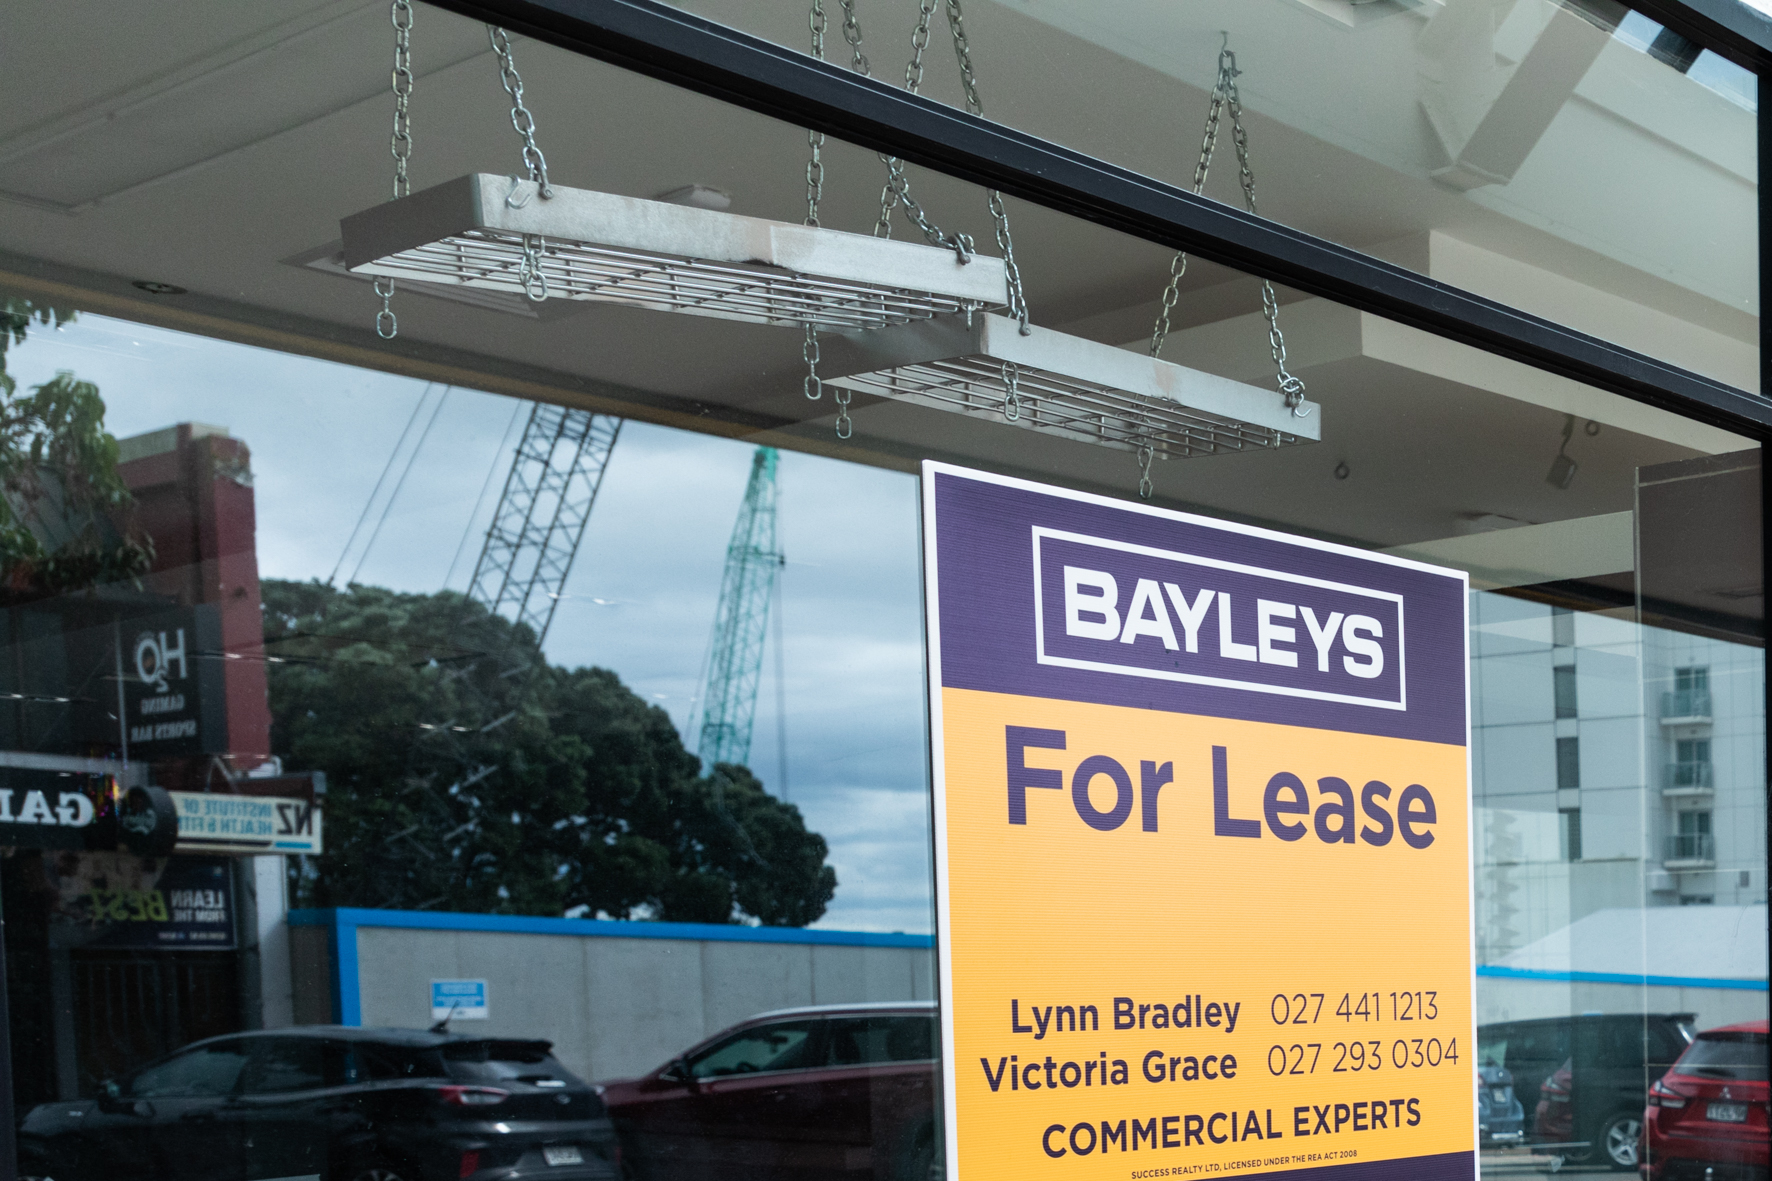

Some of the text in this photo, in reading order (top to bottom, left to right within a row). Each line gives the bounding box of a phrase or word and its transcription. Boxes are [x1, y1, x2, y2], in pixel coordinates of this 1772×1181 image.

[1064, 565, 1384, 678] BAYLEYS
[1006, 725, 1436, 849] For Lease
[1012, 995, 1240, 1040] Lynn Bradley
[1272, 992, 1438, 1025] 027 441 1213
[980, 1050, 1237, 1092] Victoria Grace
[1268, 1038, 1459, 1076] 027 293 0304
[1042, 1098, 1421, 1159] COMMERCIAL EXPERTS
[1131, 1149, 1358, 1180] SUCCESS REALTY LTD, LICENSED UNDER THE REA ACT 2008
